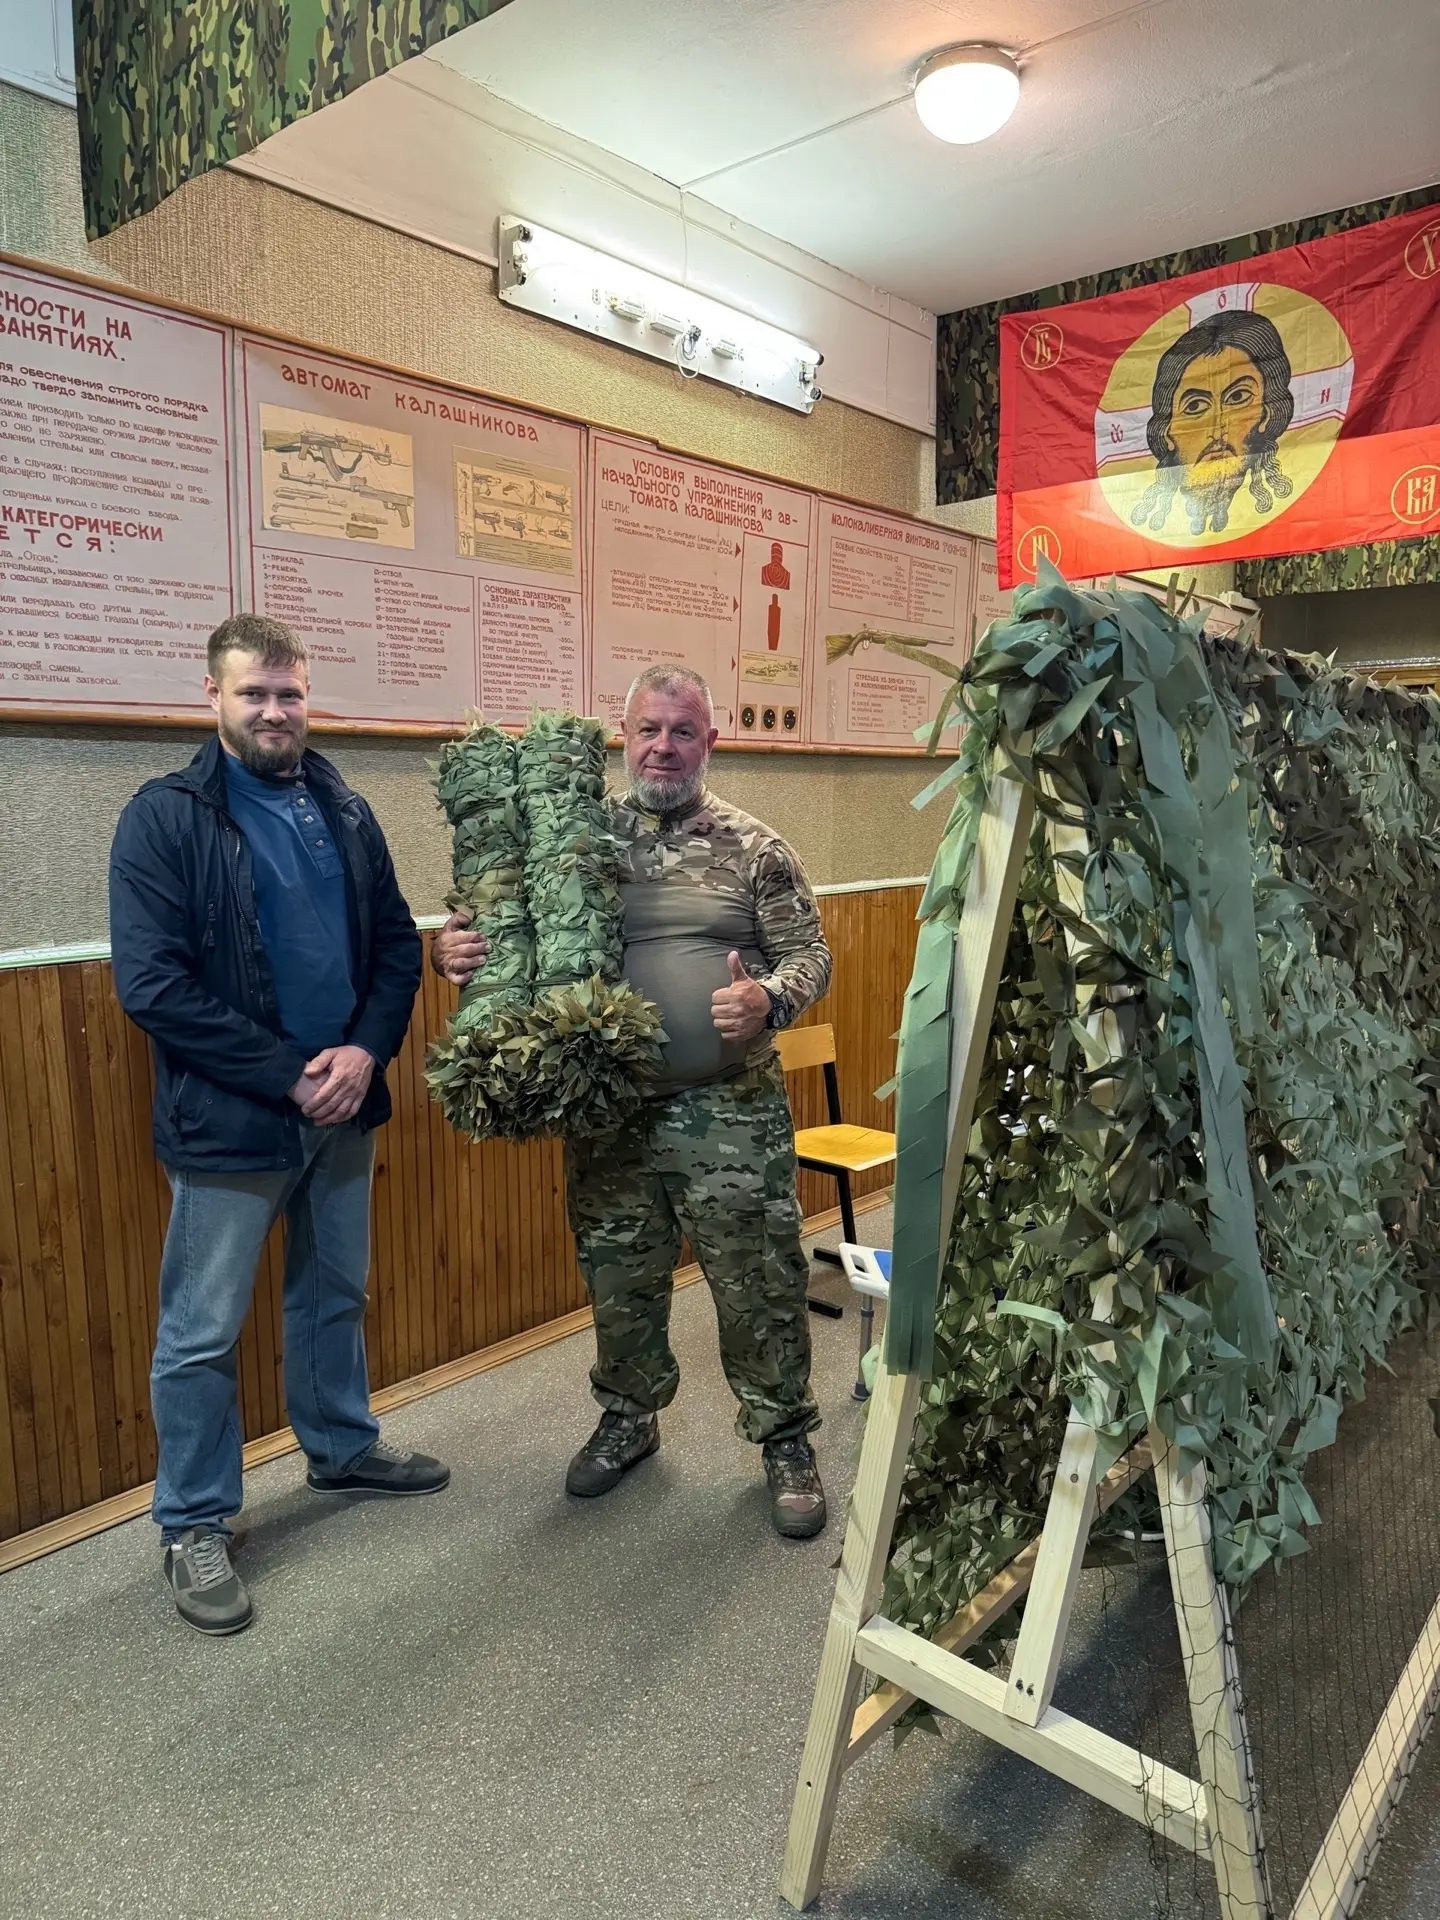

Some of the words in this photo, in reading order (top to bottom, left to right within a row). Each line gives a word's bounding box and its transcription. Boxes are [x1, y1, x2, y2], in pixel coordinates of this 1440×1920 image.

[0, 289, 85, 330] НОСТИ
[105, 316, 132, 341] НА
[2, 504, 163, 542] КАТЕГОРИЧЕСКИ
